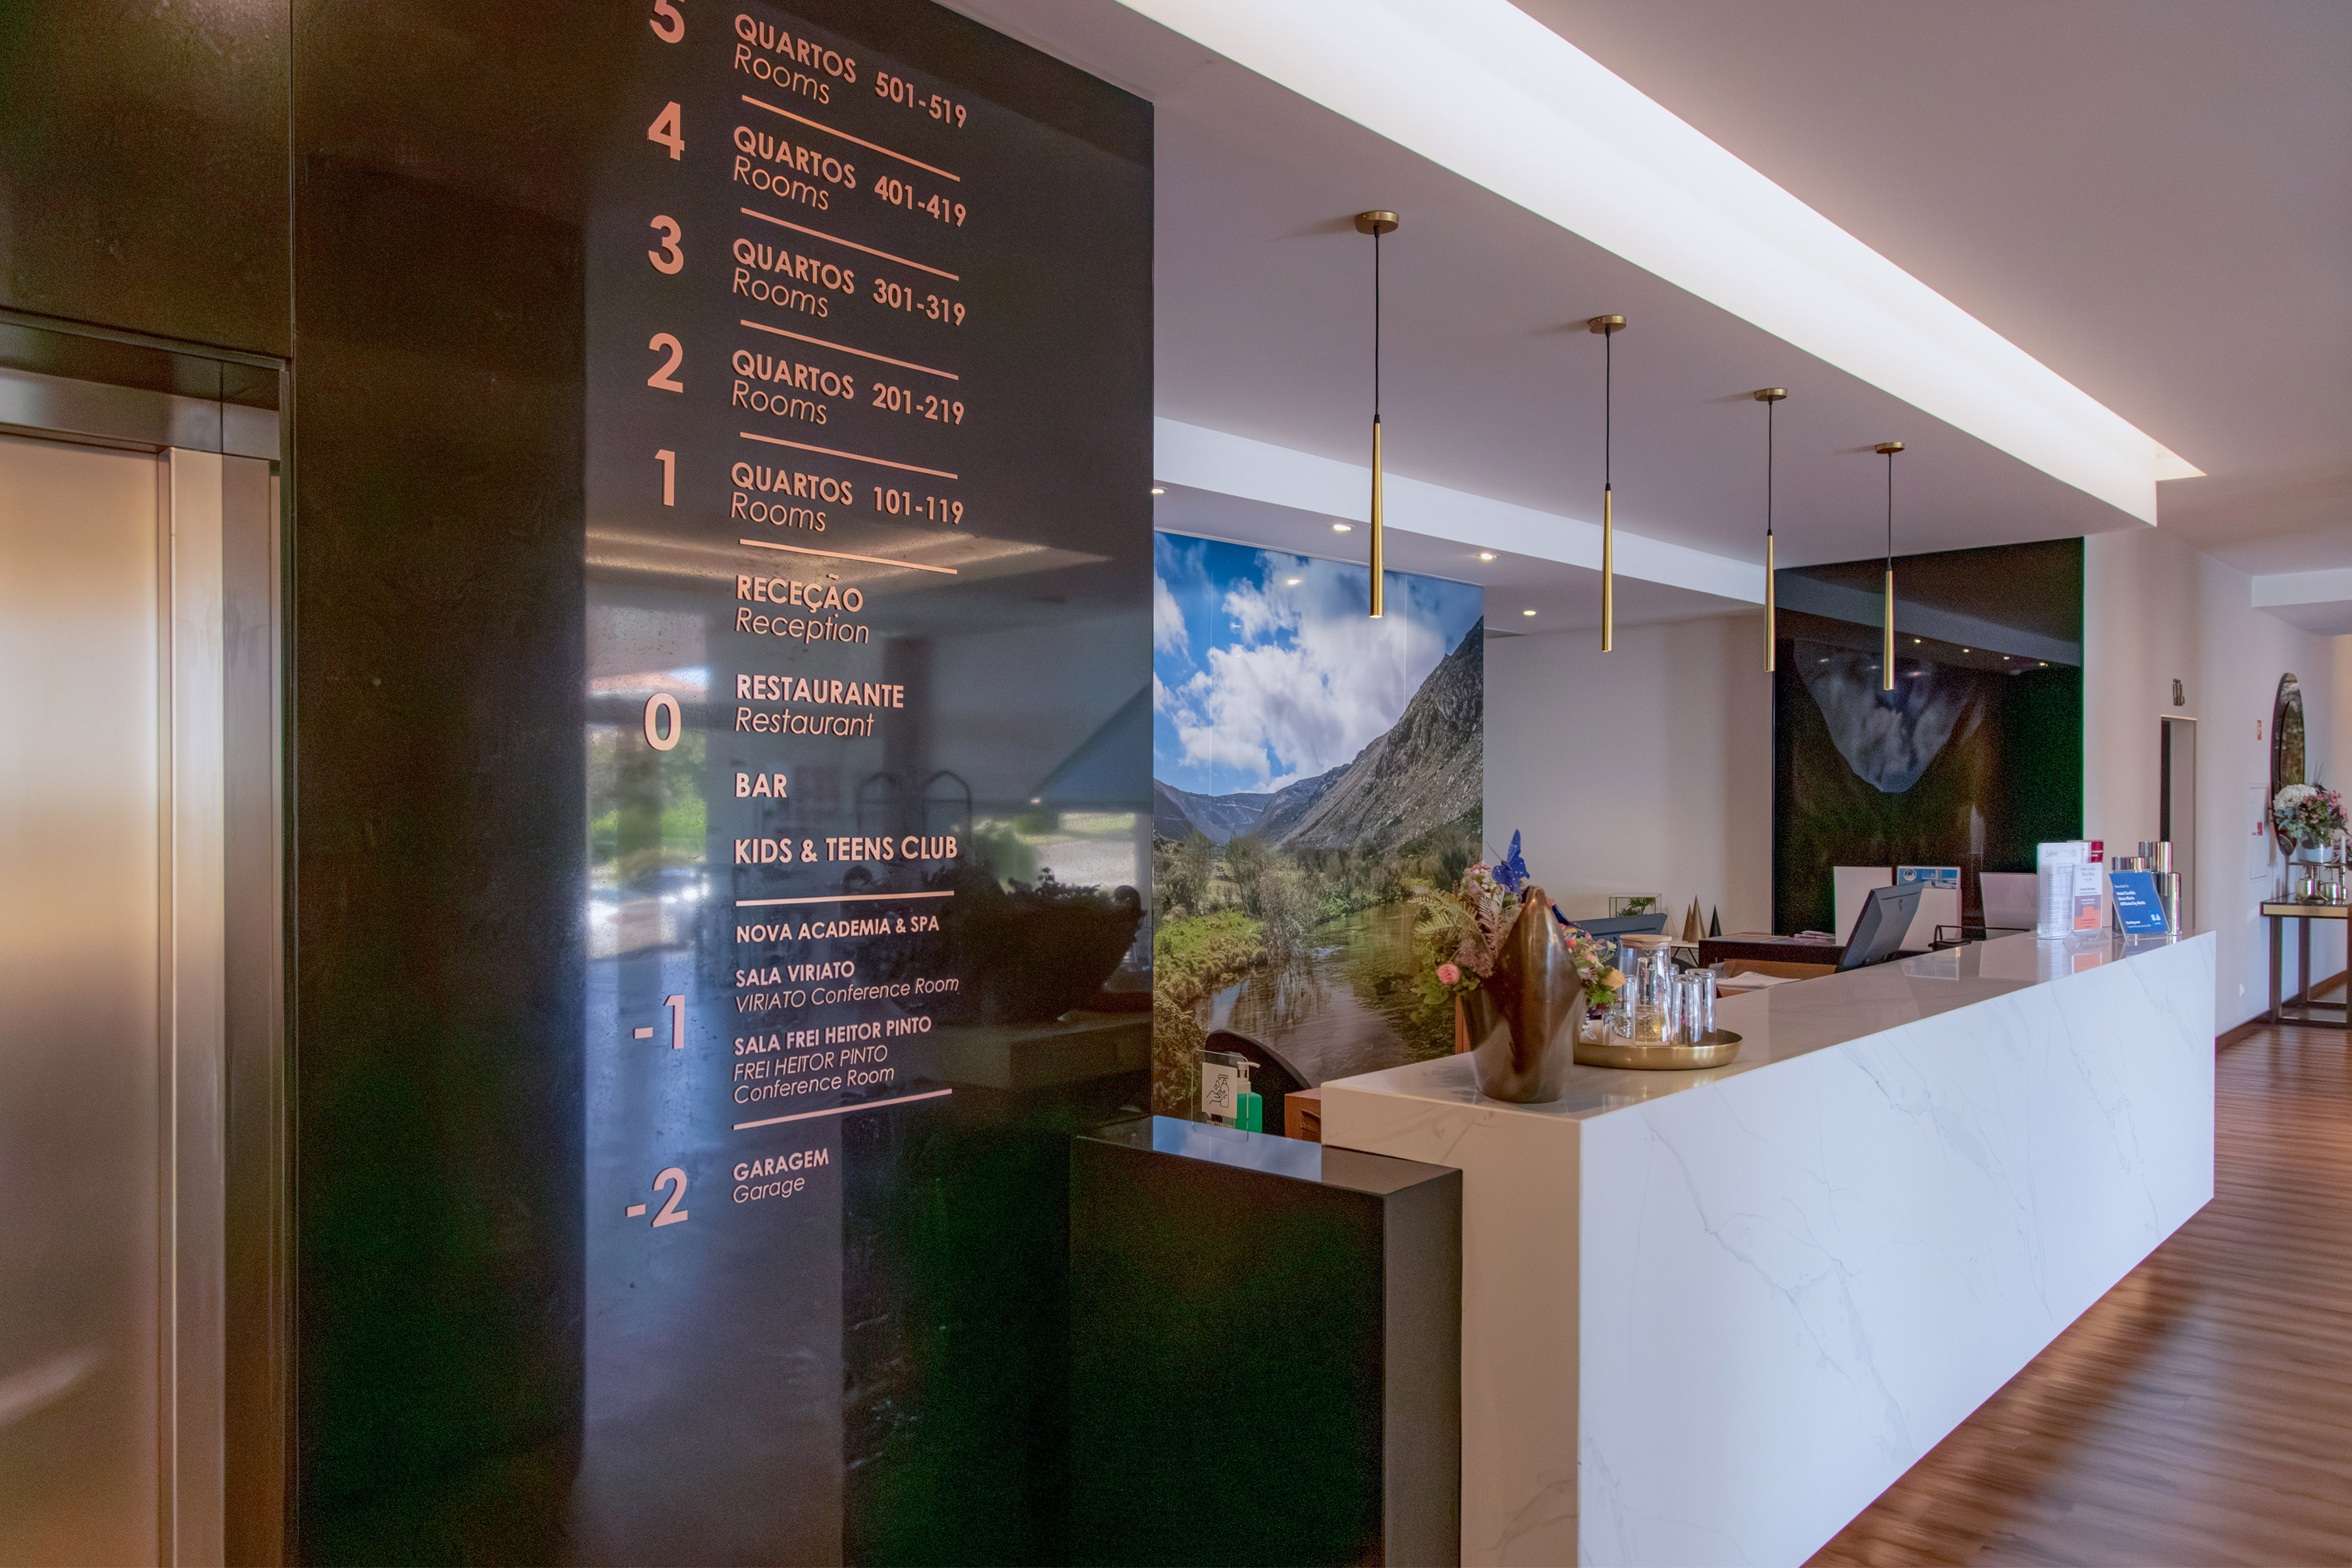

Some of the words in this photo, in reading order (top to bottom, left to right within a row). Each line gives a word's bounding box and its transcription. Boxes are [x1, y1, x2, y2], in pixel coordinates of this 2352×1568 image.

[649, 0, 685, 43] 5
[735, 14, 856, 83] QUARTOS
[875, 72, 967, 128] 501-519
[735, 43, 830, 104] Rooms
[648, 101, 685, 161] 4
[733, 155, 829, 211] Rooms
[734, 126, 856, 189] QUARTOS
[874, 176, 967, 226] 401-419
[648, 215, 684, 275] 3
[733, 238, 855, 294] QUARTOS
[874, 278, 966, 327] 301-319
[733, 267, 828, 318] Rooms
[647, 333, 683, 393] 2
[732, 349, 854, 400] QUARTOS
[872, 383, 965, 425] 201-219
[732, 380, 827, 425] Rooms
[655, 449, 676, 506] 1
[731, 462, 853, 505] QUARTOS
[874, 486, 964, 524] 101-119
[731, 492, 826, 532] Rooms
[737, 573, 863, 613] RECEÇÃO
[736, 607, 869, 644] Reception
[736, 674, 904, 708] RESTAURANTE
[644, 692, 682, 751] 0
[735, 707, 875, 737] Restaurant
[735, 772, 788, 798] BAR
[735, 838, 793, 864] KIDS
[801, 839, 818, 862] &
[826, 837, 894, 861] TEENS
[900, 836, 958, 859] CLUB
[736, 924, 793, 943] NOVA
[797, 918, 891, 941] ACADEMIA
[895, 918, 906, 933] &
[911, 916, 940, 932] SPA
[736, 966, 782, 988] SALA
[788, 960, 855, 982] VIRIATO
[736, 991, 806, 1013] VIRIATO
[811, 982, 910, 1005] Conference
[915, 976, 959, 994] Room
[633, 994, 686, 1050] -1
[735, 1034, 781, 1056] SALA
[787, 1028, 820, 1049] FREI
[825, 1022, 881, 1045] HEITOR
[886, 1016, 932, 1036] PINTO
[733, 1062, 770, 1082] FREI
[774, 1052, 835, 1079] HEITOR
[840, 1045, 888, 1067] PINTO
[733, 1077, 842, 1104] Conference
[847, 1068, 895, 1086] Room
[733, 1148, 829, 1181] GARAGEM
[625, 1167, 689, 1228] -2
[733, 1178, 805, 1204] Garage
